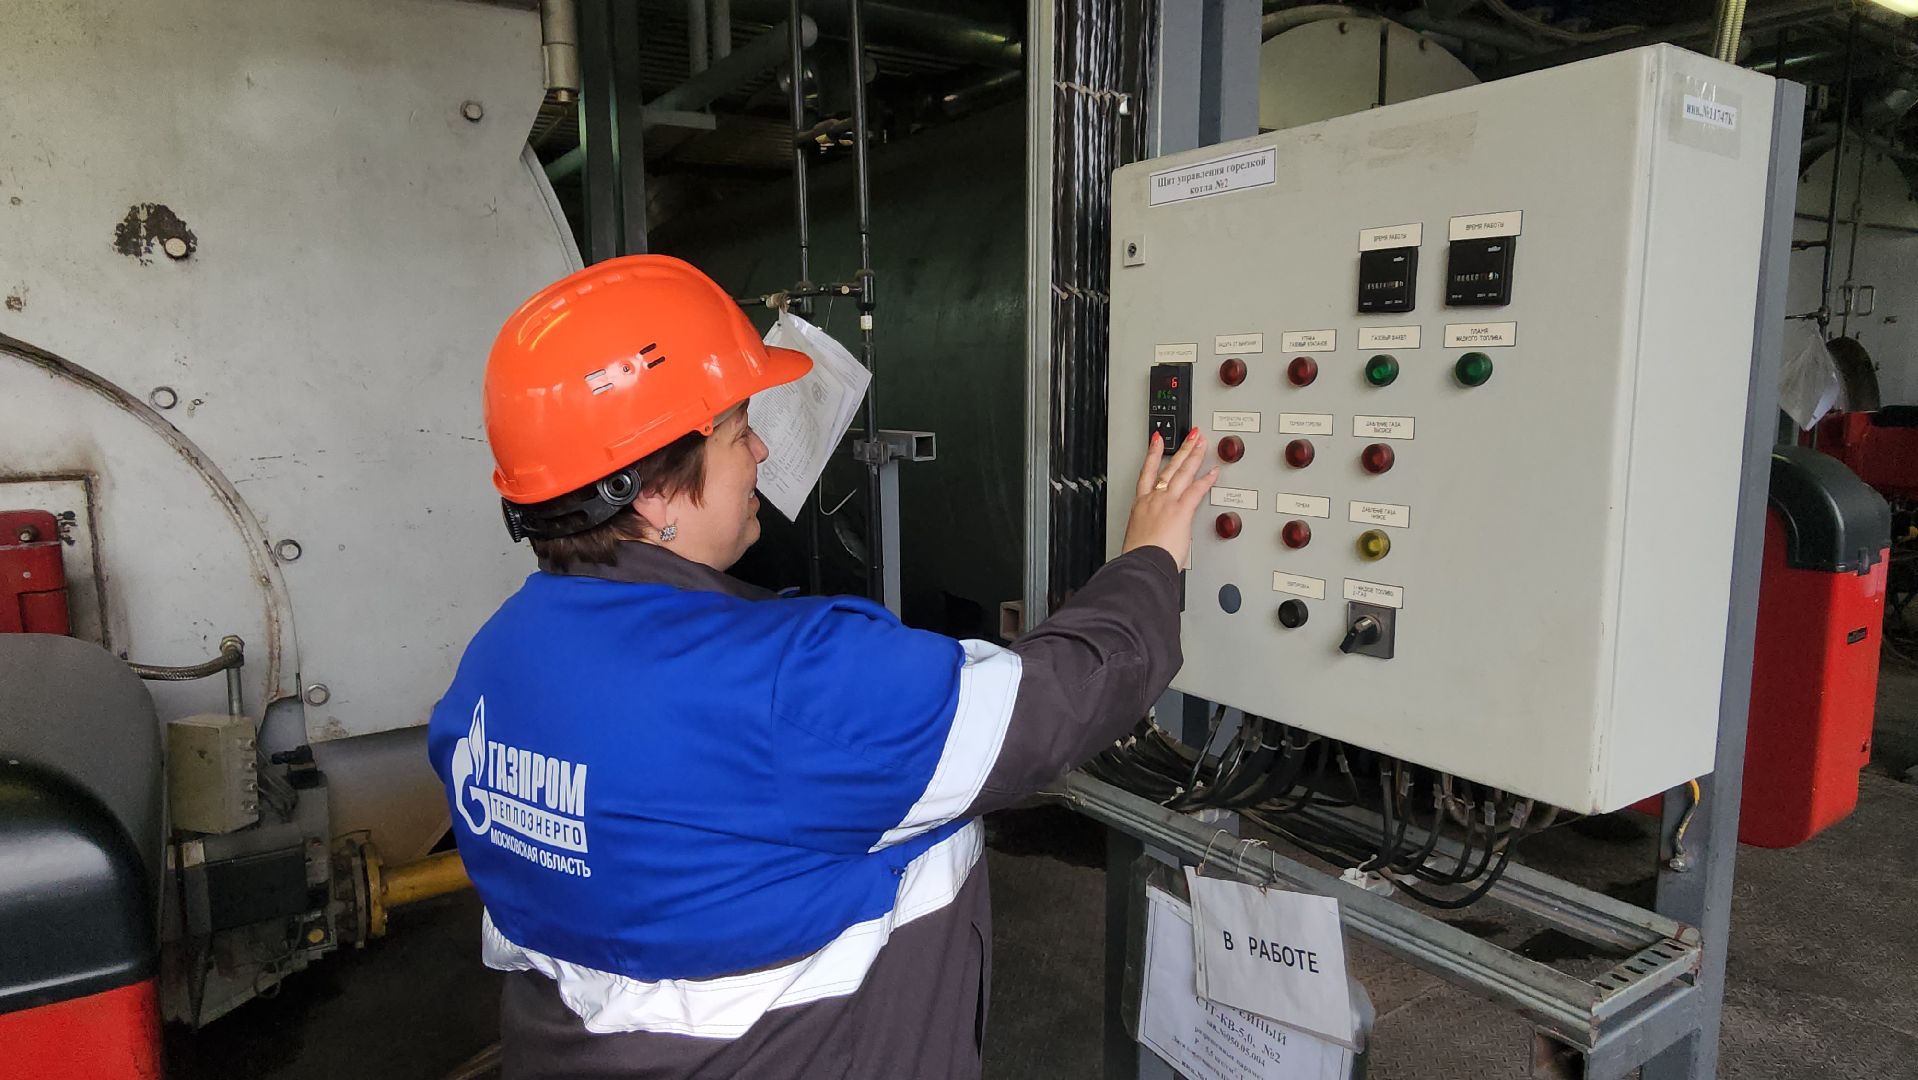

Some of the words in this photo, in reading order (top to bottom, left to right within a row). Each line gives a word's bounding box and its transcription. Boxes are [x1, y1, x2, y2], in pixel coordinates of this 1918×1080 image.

[1157, 177, 1175, 188] Щит
[1177, 166, 1224, 187] управления
[1226, 156, 1266, 175] горелкой
[1189, 184, 1213, 195] котла
[1214, 178, 1229, 191] №2
[1171, 376, 1178, 388] 6
[488, 740, 587, 817] ГАЗПРОМ
[493, 798, 582, 846] ТЕПЛОЭНЕРГО
[490, 827, 538, 864] МОСКОВСКАЯ
[539, 851, 591, 878] ОБЛАСТЬ
[1223, 930, 1234, 951] В
[1249, 936, 1319, 974] РАБОТЕ
[1261, 1043, 1281, 1064] №2
